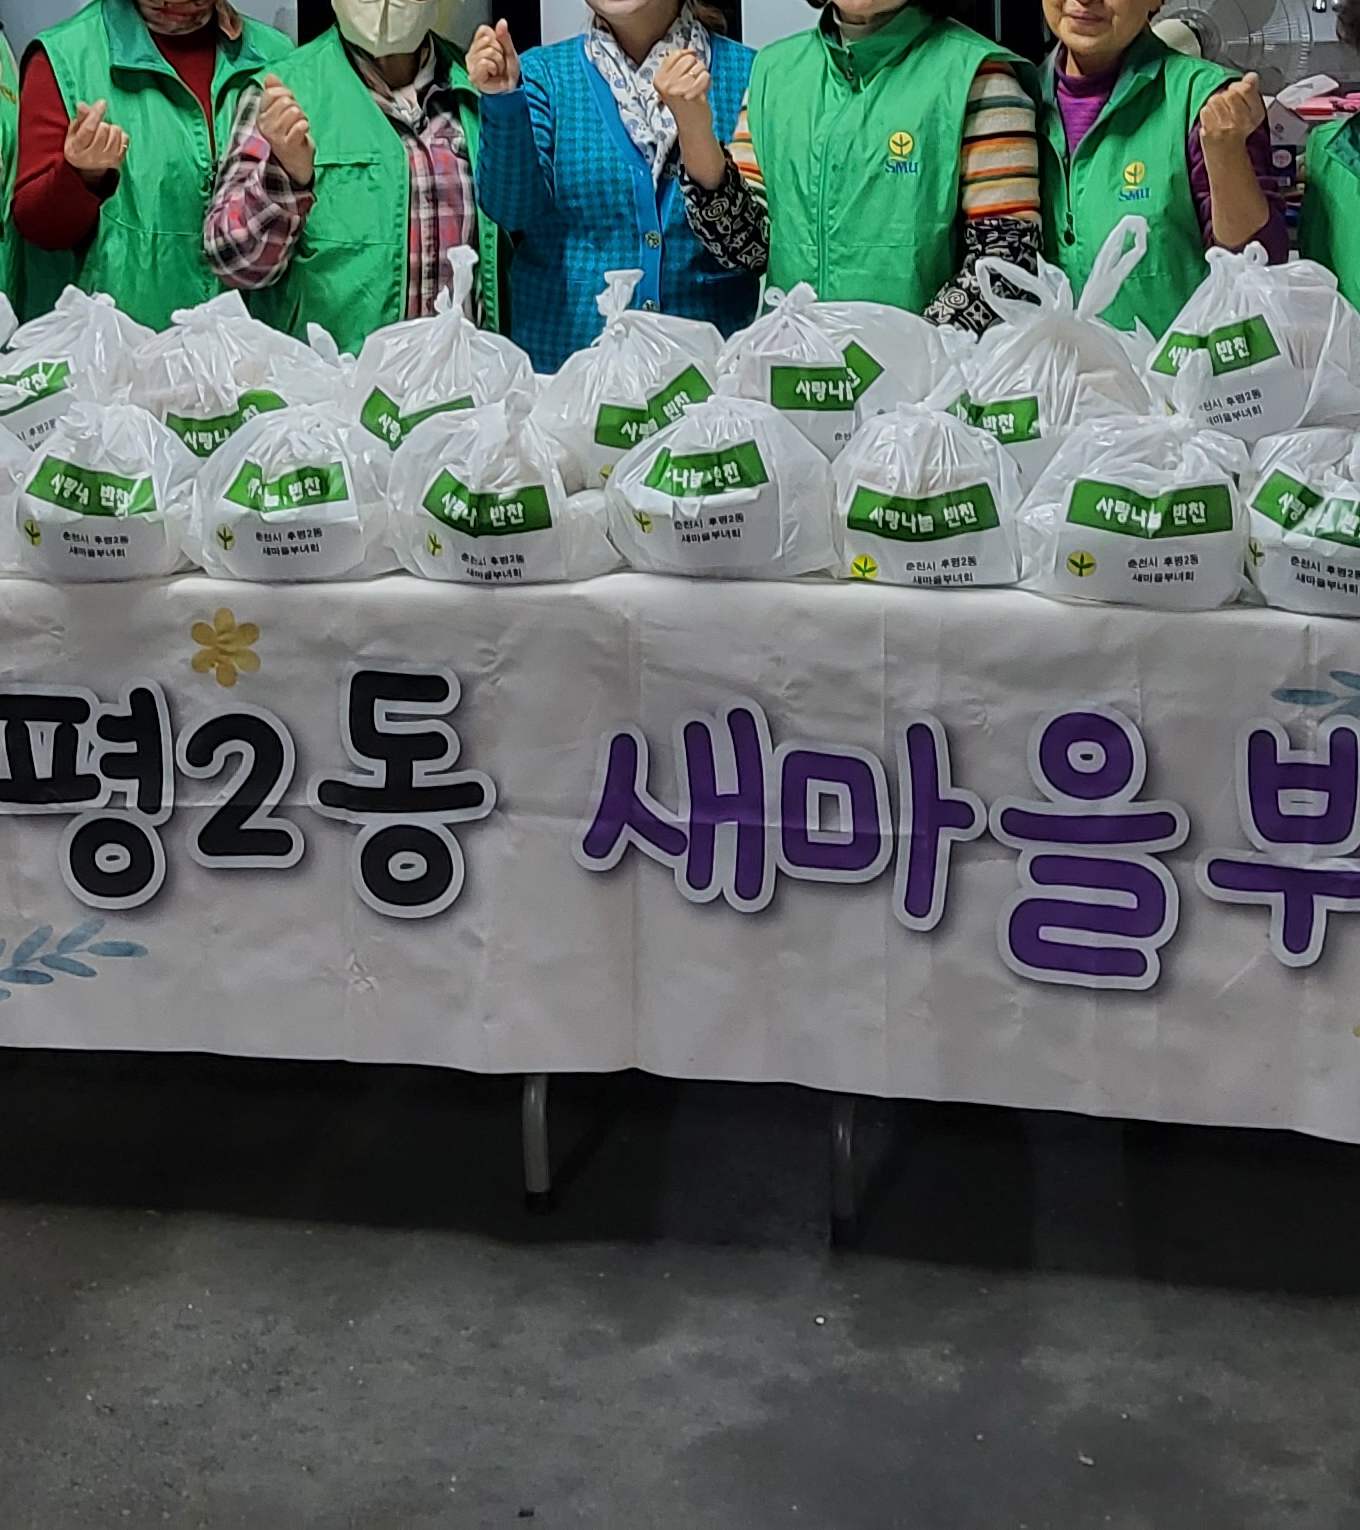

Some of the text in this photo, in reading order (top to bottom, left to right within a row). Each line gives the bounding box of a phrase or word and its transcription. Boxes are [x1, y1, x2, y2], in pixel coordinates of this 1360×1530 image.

[884, 160, 919, 174] SMU
[1118, 186, 1151, 202] SMU
[1215, 336, 1251, 364] 반찬
[183, 428, 230, 451] 사랑나
[288, 476, 322, 499] 반찬
[489, 501, 524, 527] 반찬
[674, 512, 744, 530] 춘천시 후평2동
[868, 501, 978, 533] 사랑나눔 반찬
[1095, 496, 1207, 530] 사랑나눔 반찬
[94, 534, 130, 545] 후평2동
[287, 526, 323, 541] 후평2동
[681, 529, 741, 543] 새마을부녀회
[68, 545, 126, 558] 새마을부녀회
[262, 542, 320, 556] 새마을부녀회
[490, 553, 525, 567] 후평2동
[906, 555, 978, 572] 춘천시 후평2동
[1127, 554, 1199, 569] 춘천시 후평2동
[1290, 556, 1321, 573] 춘천시
[912, 572, 974, 585] 새마을부녀회
[1131, 570, 1195, 584] 새마을부녀회
[1296, 572, 1359, 596] 새마을부녀회
